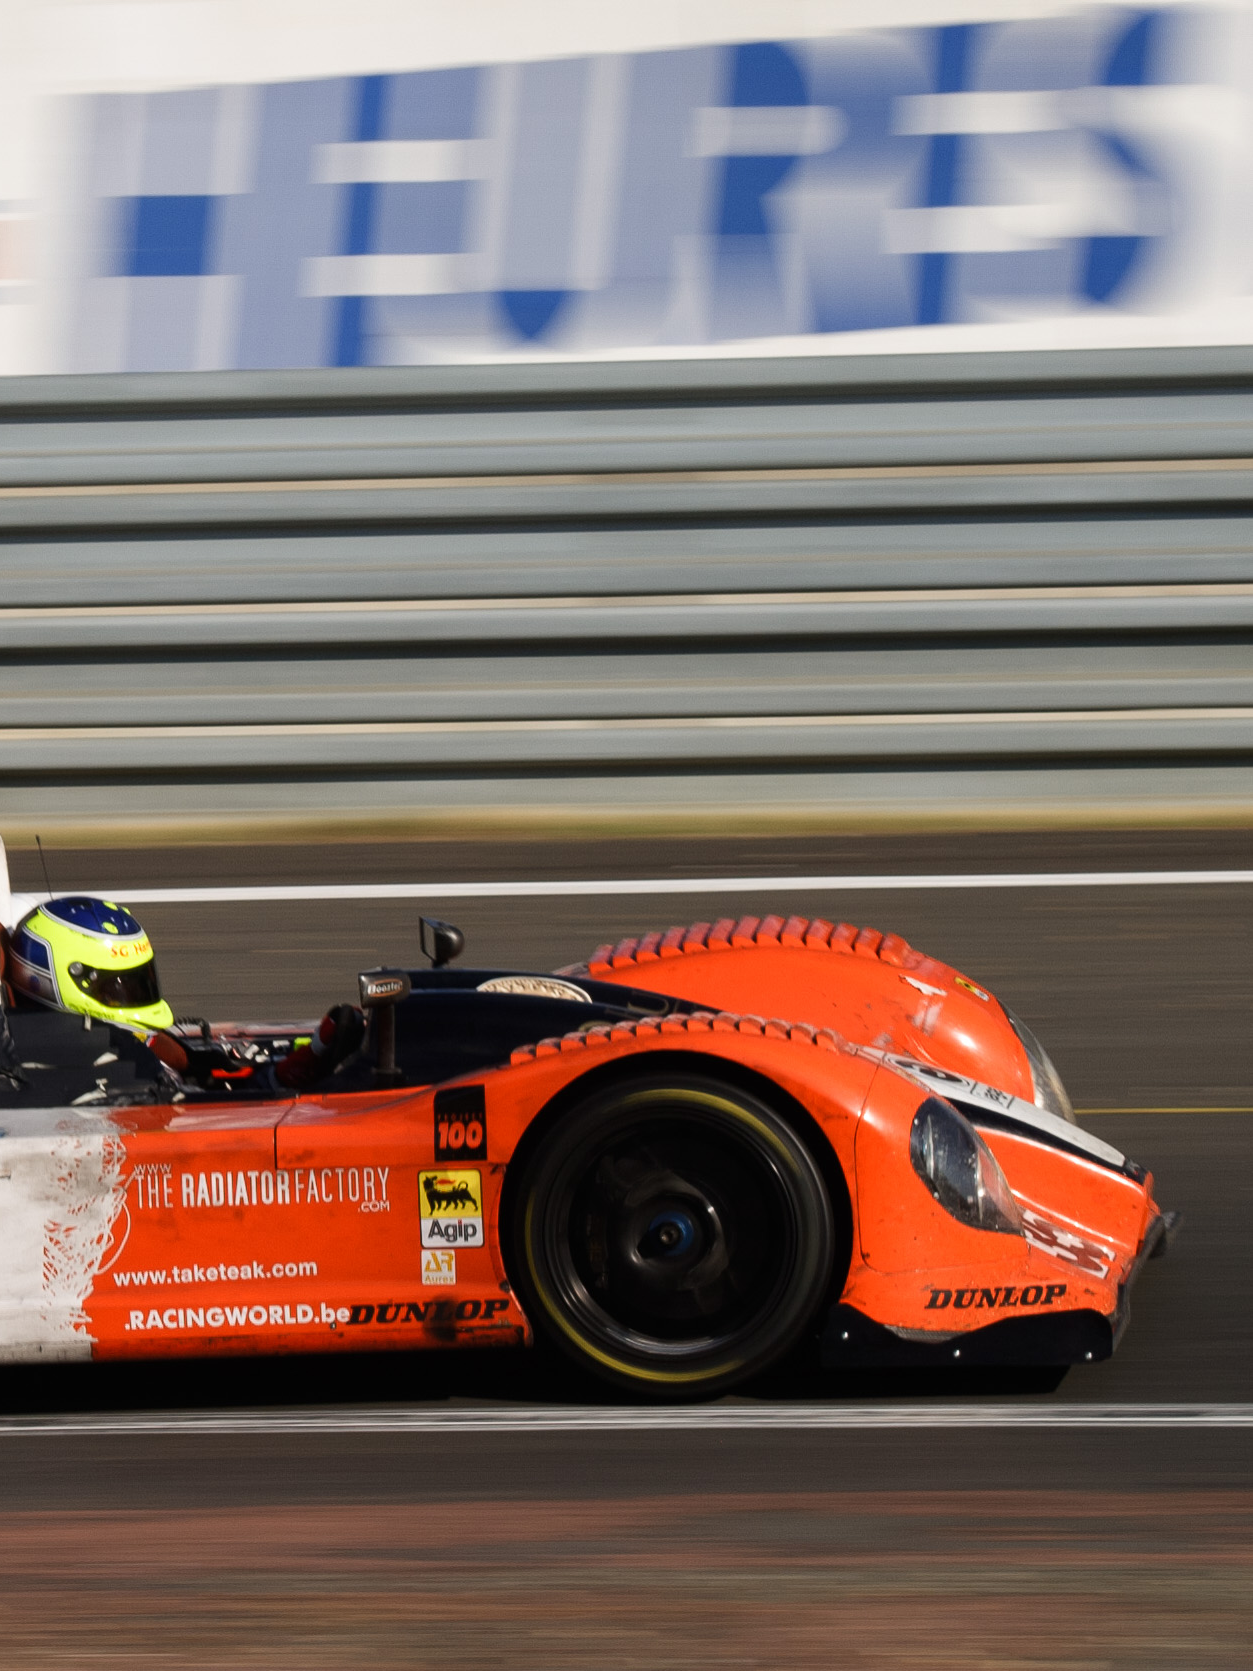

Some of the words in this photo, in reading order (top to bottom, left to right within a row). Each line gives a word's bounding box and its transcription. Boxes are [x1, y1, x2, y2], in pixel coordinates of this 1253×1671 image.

[438, 1120, 483, 1149] 100
[135, 1173, 173, 1209] THE
[358, 1200, 390, 1212] .COM
[428, 1219, 477, 1242] Agip
[113, 1260, 318, 1287] www.taketeak.com
[924, 1284, 1067, 1309] DUNLOP
[124, 1302, 350, 1330] .RACINGWORLD.be
[346, 1299, 510, 1326] DUNLOP
